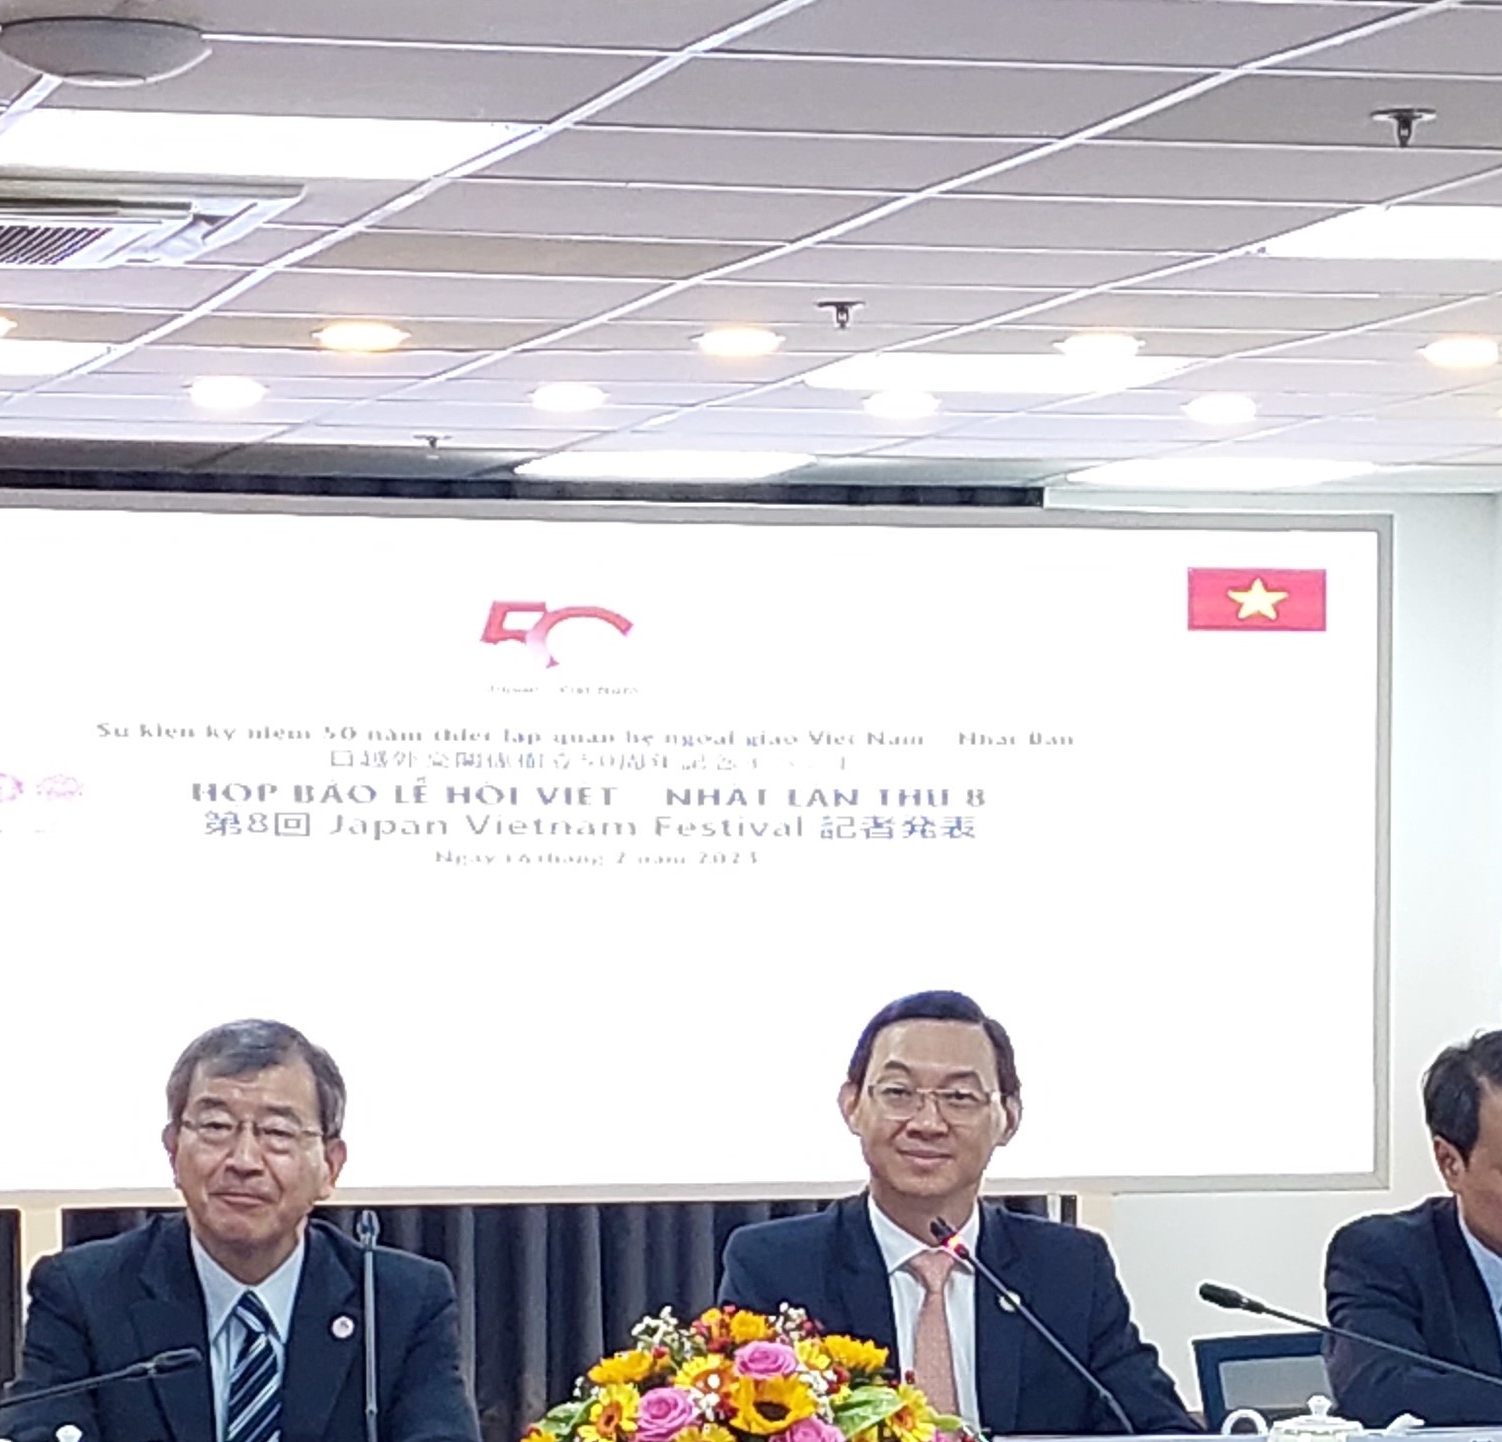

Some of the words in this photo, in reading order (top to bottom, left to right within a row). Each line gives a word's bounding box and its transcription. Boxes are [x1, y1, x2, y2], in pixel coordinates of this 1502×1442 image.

[329, 814, 448, 841] Japan
[466, 814, 637, 837] Vietnam
[655, 816, 803, 838] Festival
